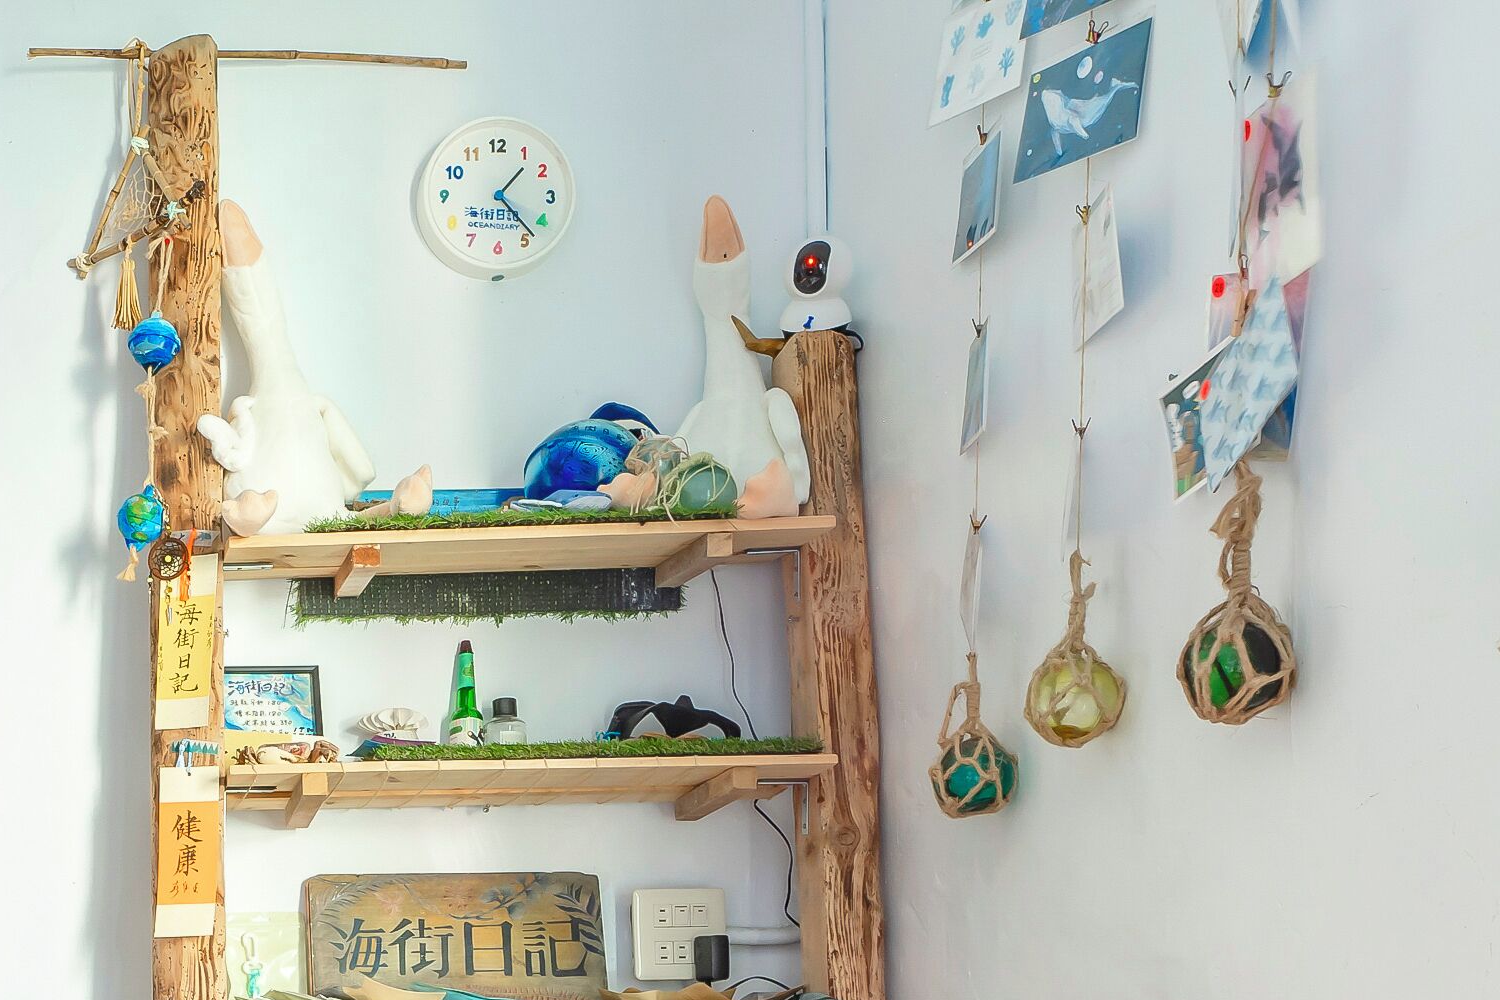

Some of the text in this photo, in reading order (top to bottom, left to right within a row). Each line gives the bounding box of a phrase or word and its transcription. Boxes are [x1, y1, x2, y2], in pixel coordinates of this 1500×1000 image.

[488, 138, 507, 153] 12
[520, 146, 527, 160] 1
[463, 146, 480, 161] 11
[445, 165, 464, 180] 10
[537, 163, 547, 178] 2
[439, 189, 450, 204] 9
[545, 189, 556, 204] 3
[464, 206, 519, 222] 海街日記
[466, 233, 477, 247] 7
[493, 240, 503, 255] 6
[520, 233, 530, 248] 5
[171, 809, 204, 877] 健康
[329, 918, 589, 979] 海街日記
